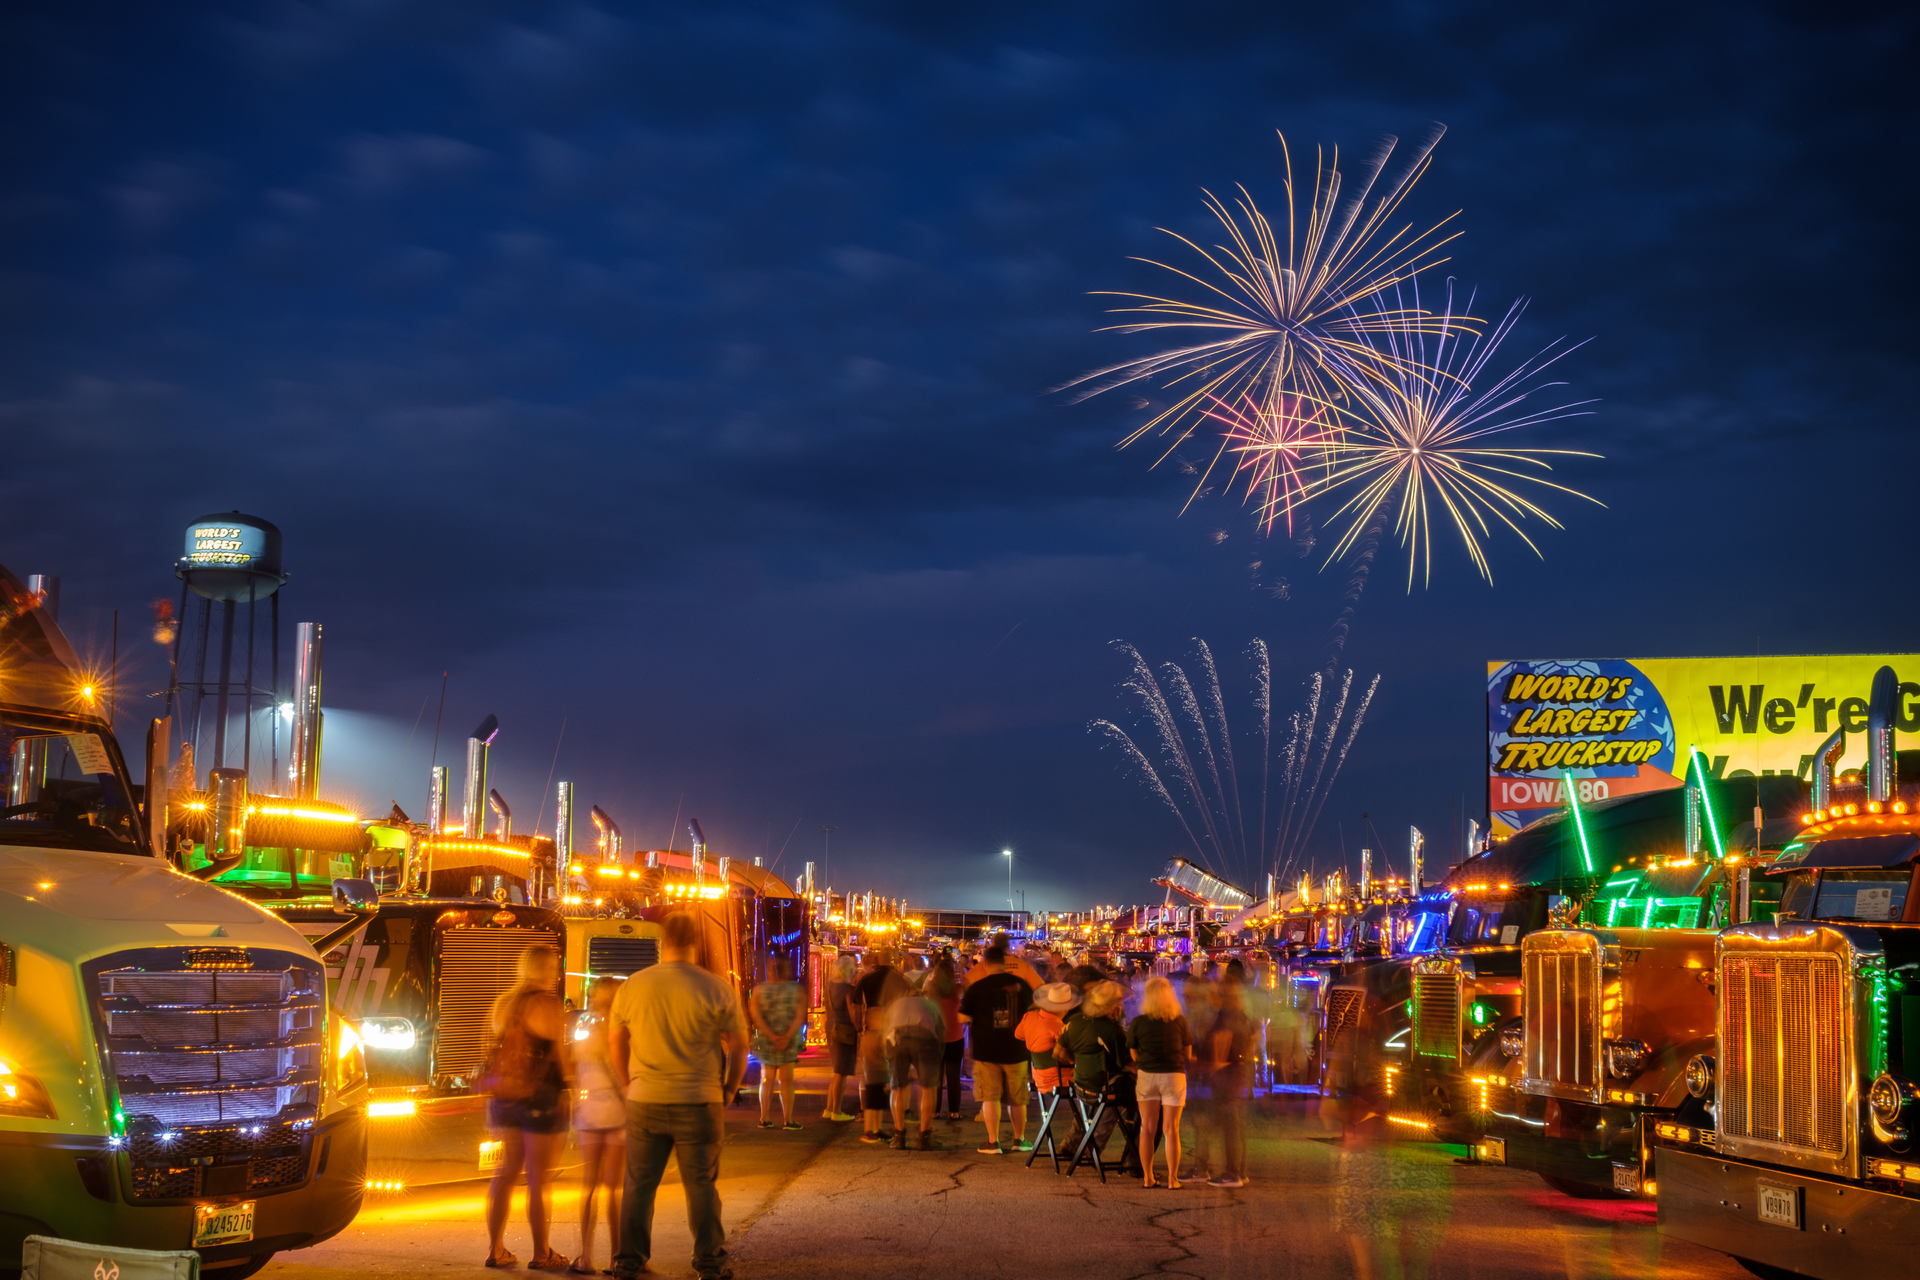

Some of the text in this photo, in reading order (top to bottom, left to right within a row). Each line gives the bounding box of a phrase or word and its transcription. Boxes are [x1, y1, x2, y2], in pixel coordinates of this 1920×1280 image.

[195, 528, 241, 538] WORLD'S
[195, 539, 242, 551] LARGEST
[1506, 673, 1633, 703] WORLD'S
[1708, 683, 1869, 734] We're
[1511, 708, 1638, 736] LARGEST
[1498, 739, 1663, 771] TRUCKSTOP
[1502, 780, 1609, 804] IOWA 80
[1625, 949, 1641, 962] 27
[206, 1212, 252, 1235] 3245276
